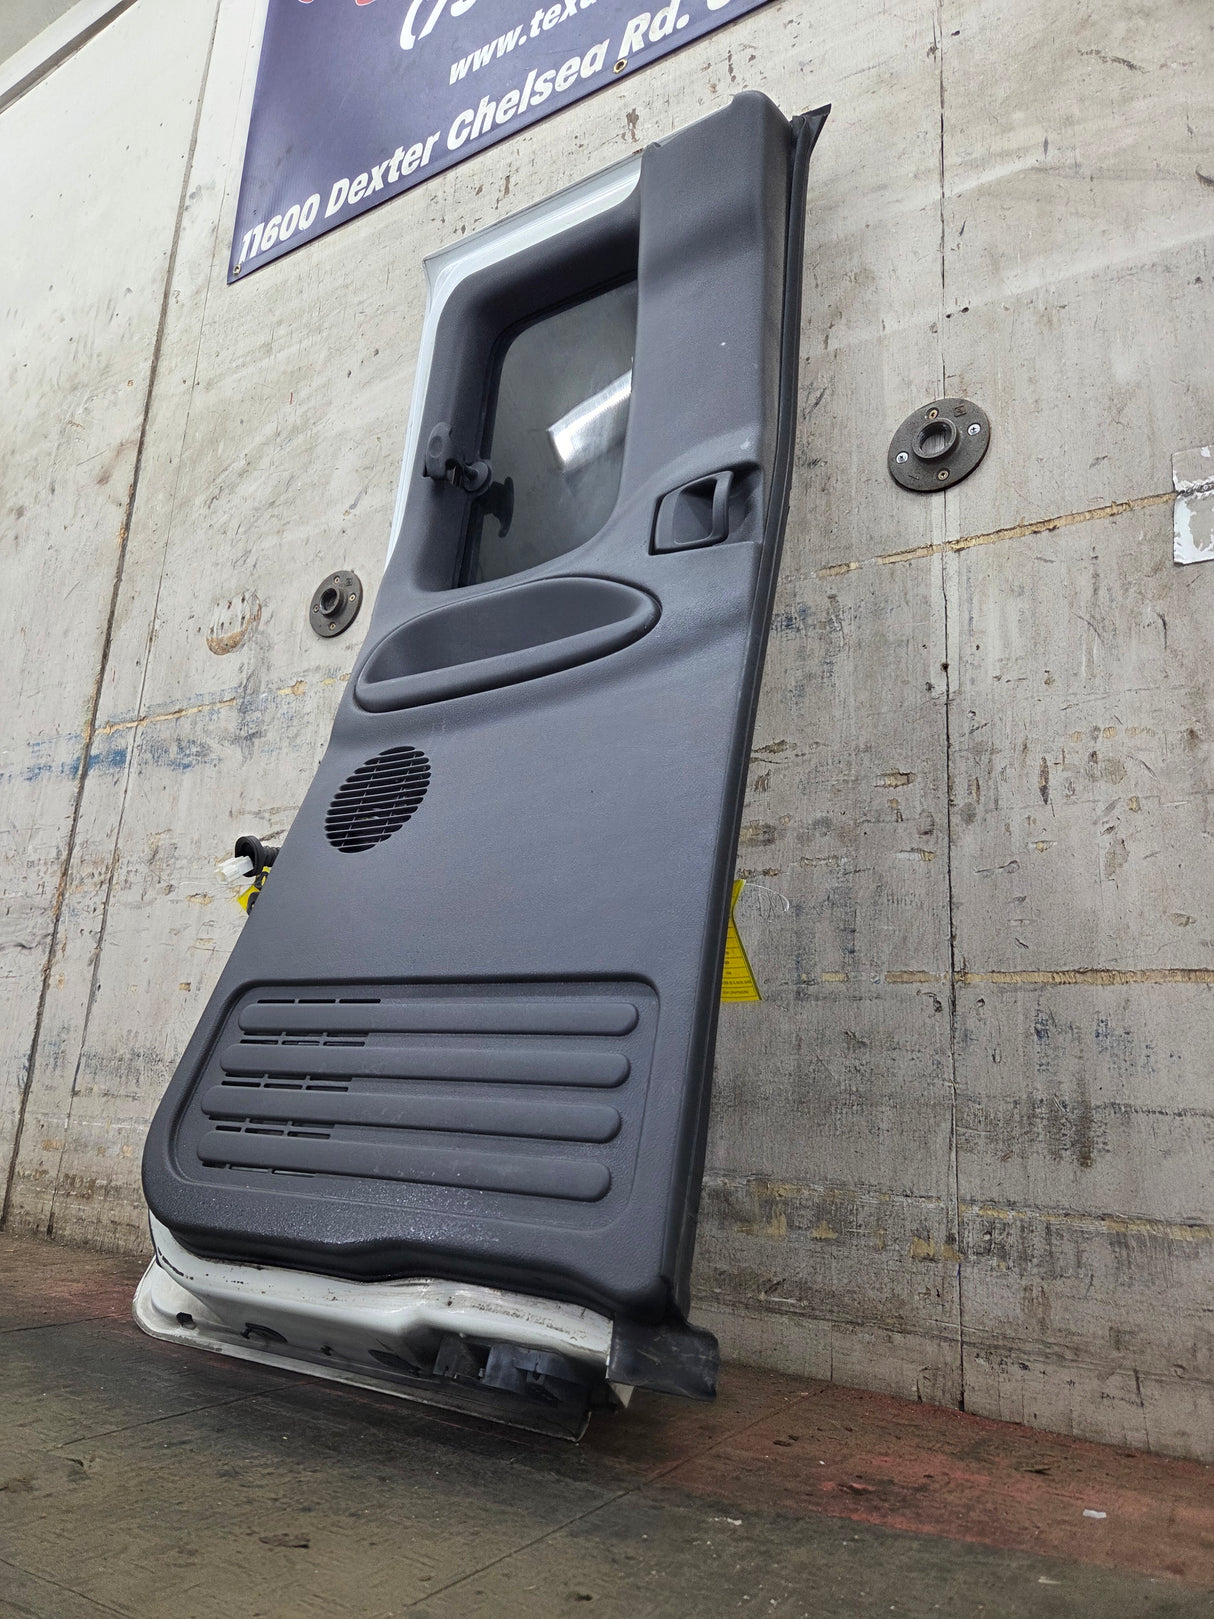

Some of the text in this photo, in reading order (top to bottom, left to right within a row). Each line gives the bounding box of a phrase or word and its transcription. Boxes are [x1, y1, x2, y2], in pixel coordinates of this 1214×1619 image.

[239, 0, 690, 263] 11600 Dexter Chelsea Rd.
